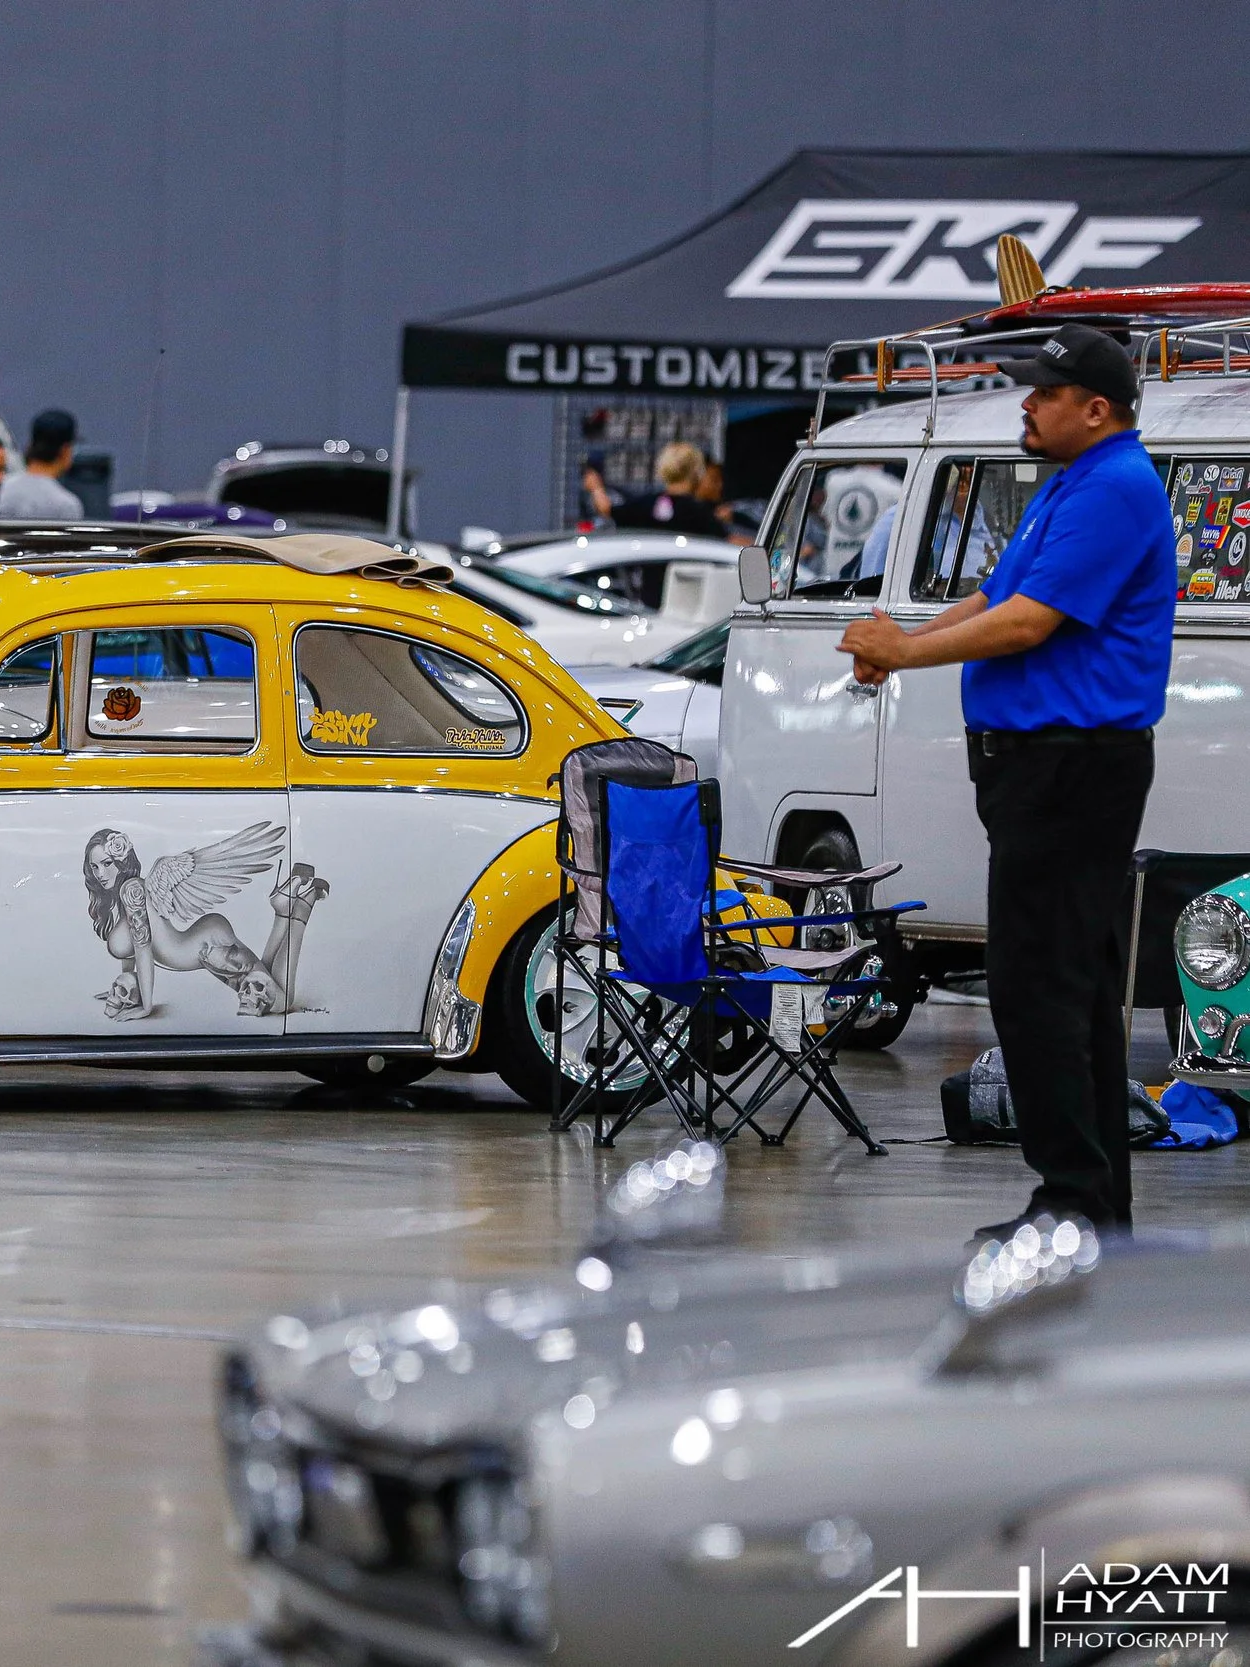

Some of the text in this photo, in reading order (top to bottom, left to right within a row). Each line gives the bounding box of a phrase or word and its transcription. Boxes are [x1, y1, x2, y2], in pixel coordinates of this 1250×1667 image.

[1042, 339, 1069, 359] RITY
[506, 343, 834, 390] CUSTOMIZE
[1214, 579, 1242, 600] illest
